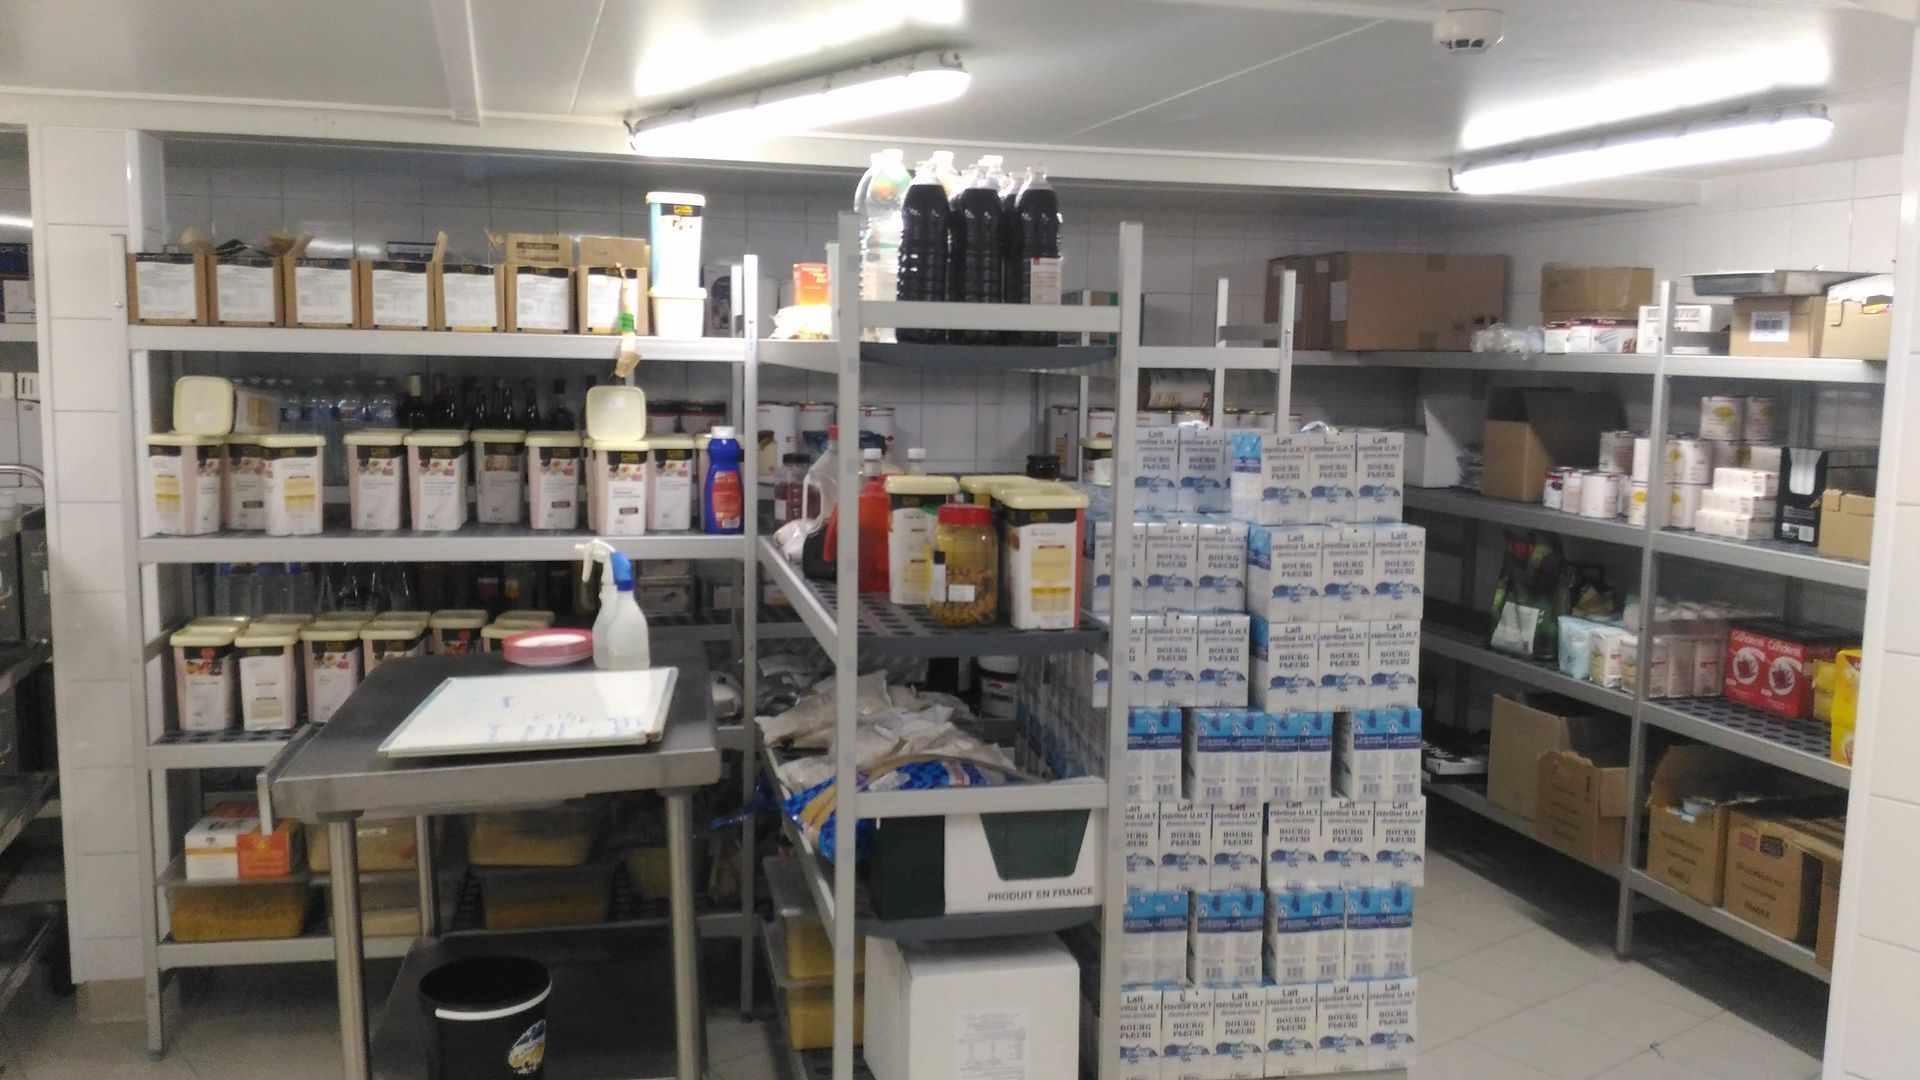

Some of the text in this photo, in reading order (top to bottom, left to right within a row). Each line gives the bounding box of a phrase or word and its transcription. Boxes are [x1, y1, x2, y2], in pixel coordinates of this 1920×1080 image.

[988, 887, 1093, 900] PRODUIT EN FRANCE
